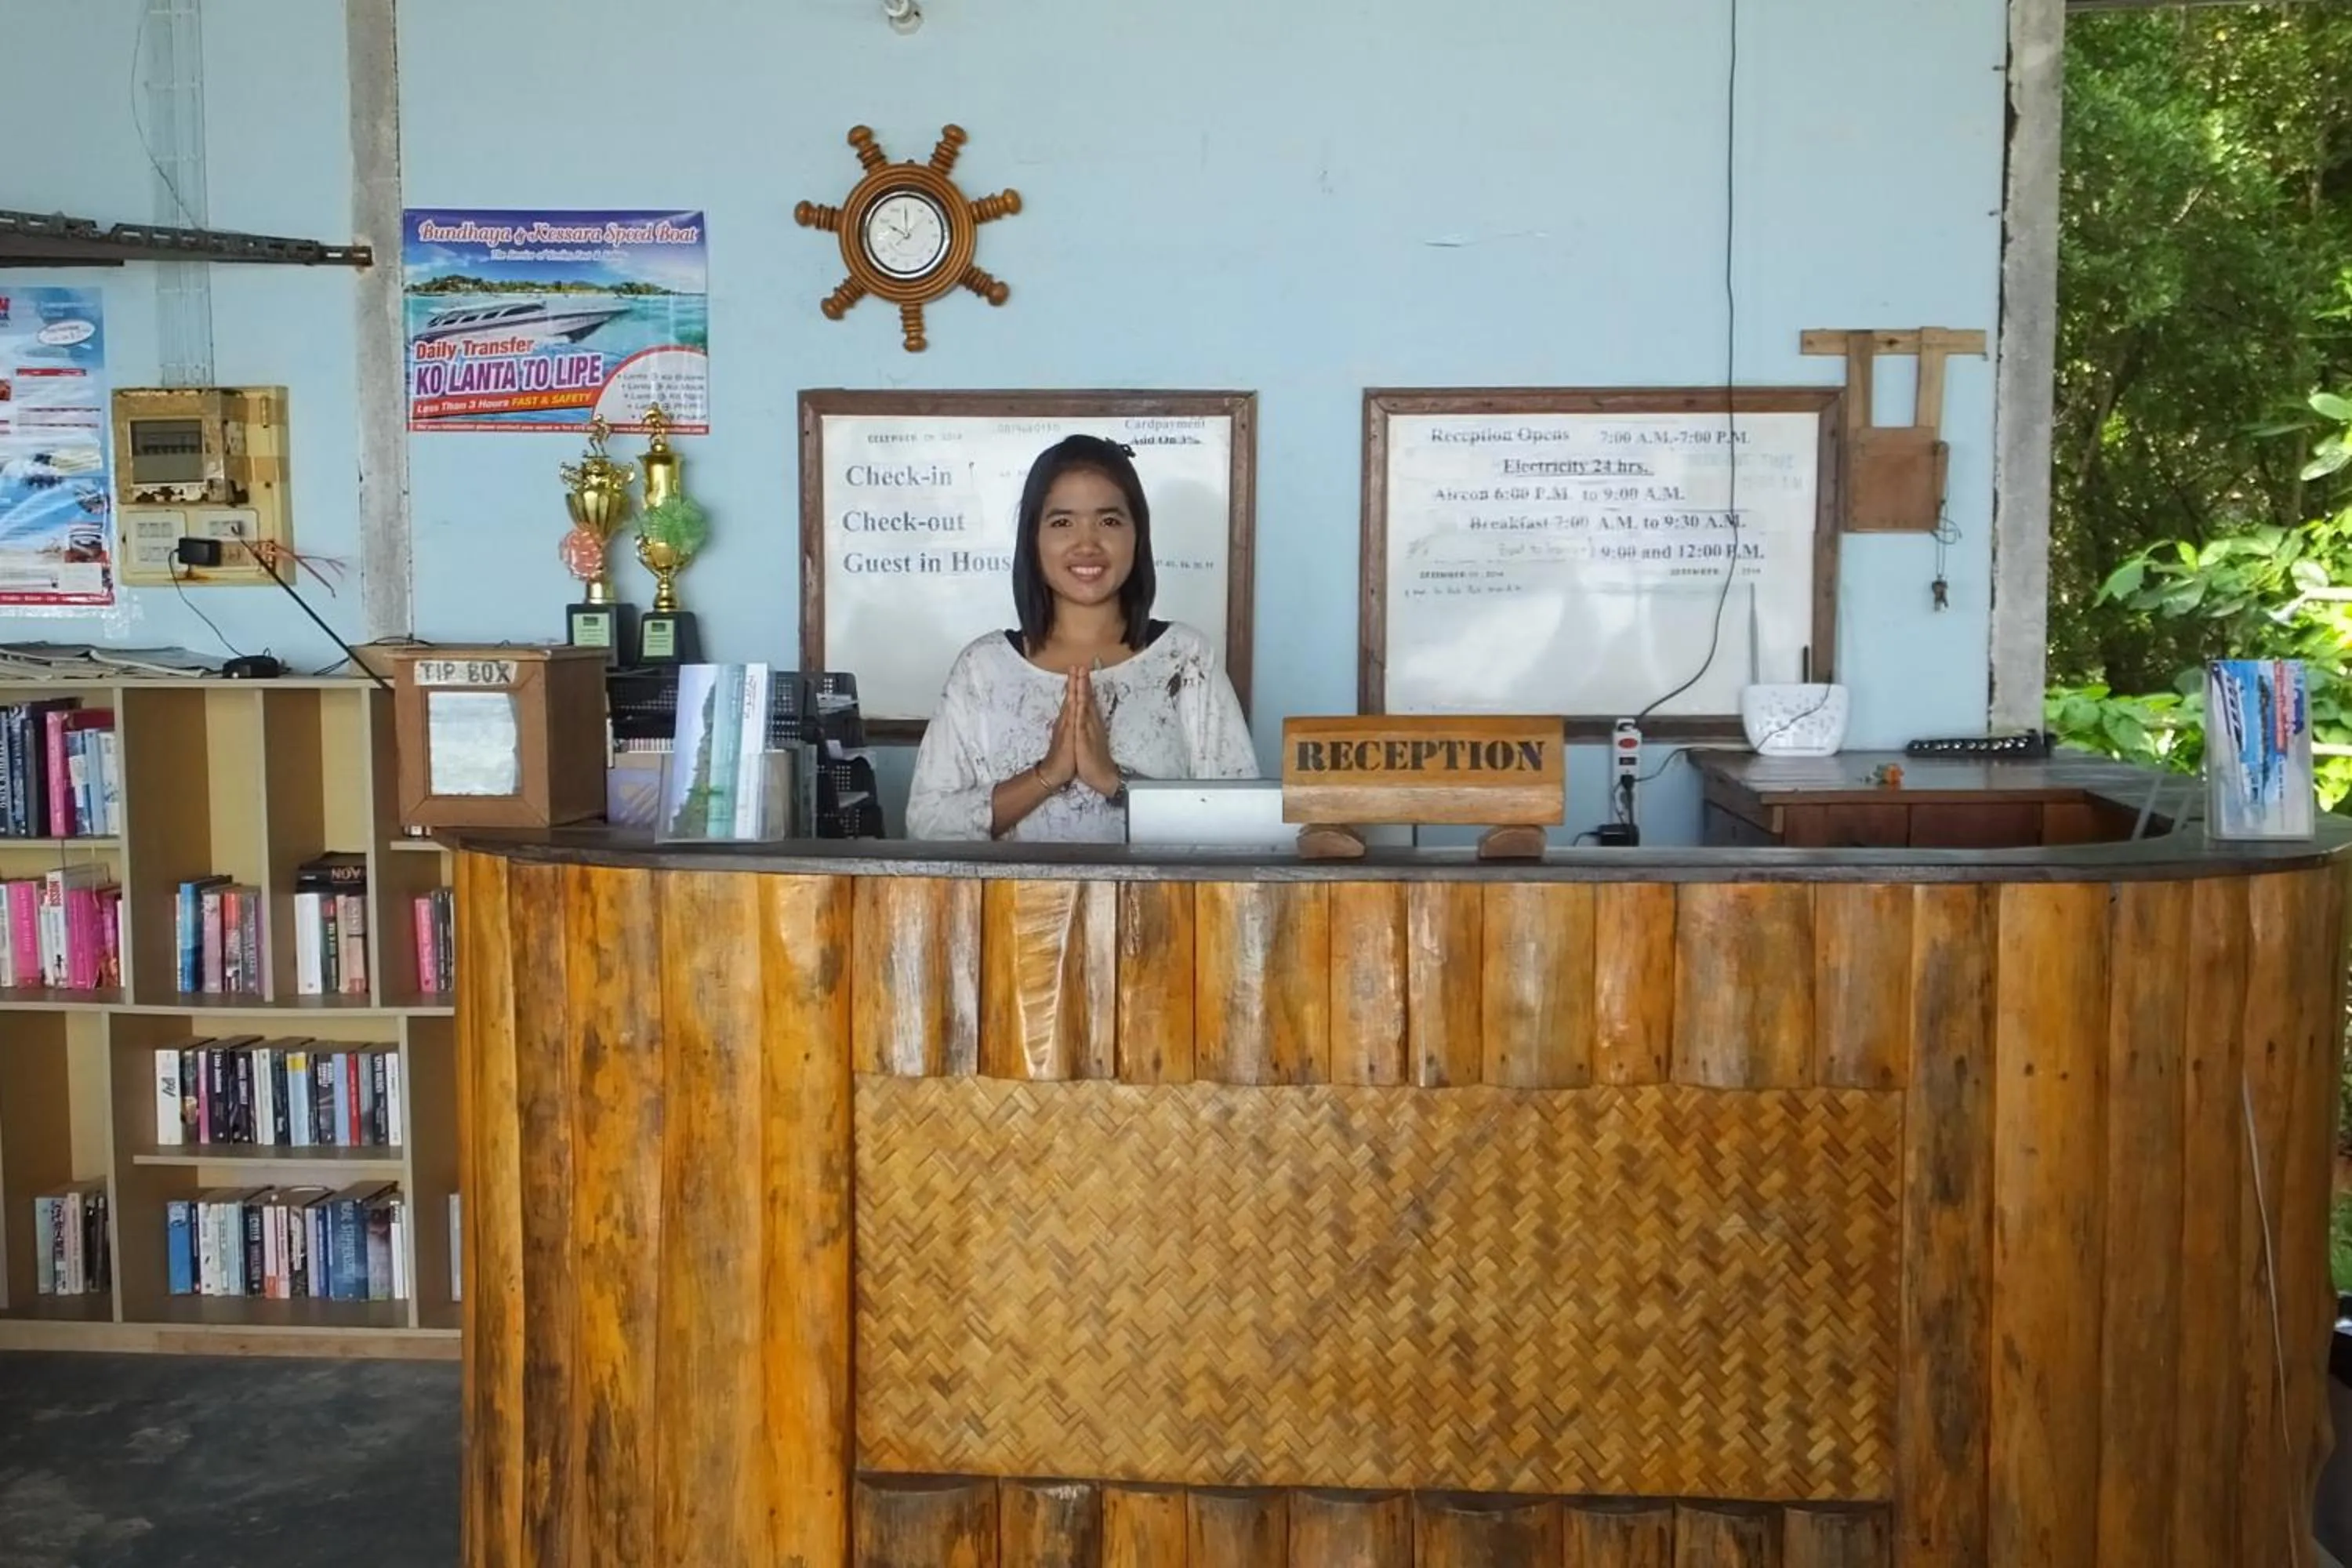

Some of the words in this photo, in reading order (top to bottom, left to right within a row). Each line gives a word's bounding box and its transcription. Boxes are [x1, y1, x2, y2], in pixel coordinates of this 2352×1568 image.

[419, 220, 512, 248] Bundhaya
[604, 222, 654, 248] Speed
[655, 220, 697, 244] Boat
[416, 341, 456, 360] Daily
[463, 337, 535, 357] Transfer
[416, 363, 443, 395] KO
[448, 360, 517, 392] LANTA
[523, 358, 550, 388] TO
[555, 354, 601, 386] LIPE
[441, 401, 466, 412] Than
[478, 398, 510, 408] Hours
[511, 396, 538, 407] FAST
[550, 393, 593, 405] SAFETY
[1431, 428, 1514, 445] Reception
[1517, 427, 1570, 445] Opens
[845, 465, 953, 487] Check-in
[1503, 458, 1587, 477] Electricity
[1617, 459, 1649, 474] hrs.
[1582, 489, 1598, 502] to
[1603, 487, 1639, 502] 9:00
[1643, 487, 1686, 501] A.M.
[842, 510, 967, 532] Check-out
[1469, 515, 1548, 531] Breakfast
[1599, 515, 1638, 530] A.M.
[1643, 517, 1660, 528] to
[1664, 515, 1699, 528] 9:30
[1705, 514, 1746, 529] A.M.
[1641, 544, 1671, 559] and
[1679, 543, 1722, 559] 12:00
[844, 552, 911, 574] Guest
[920, 552, 942, 573] in
[952, 551, 1013, 573] Hous
[419, 663, 456, 681] TIP
[467, 662, 511, 684] BOX
[1295, 739, 1545, 772] RECEPTION
